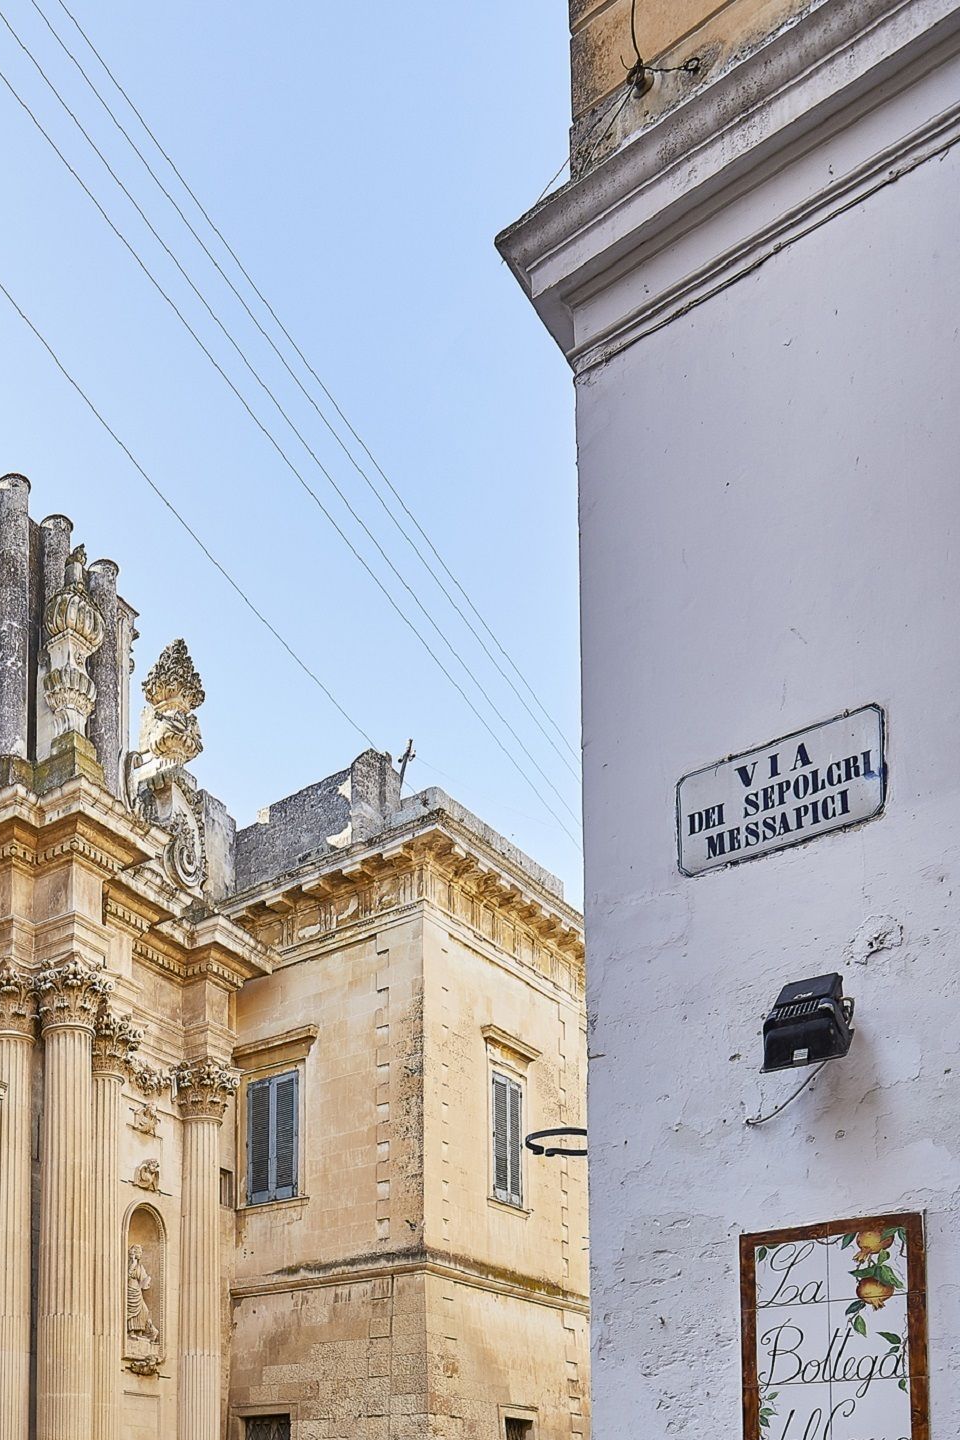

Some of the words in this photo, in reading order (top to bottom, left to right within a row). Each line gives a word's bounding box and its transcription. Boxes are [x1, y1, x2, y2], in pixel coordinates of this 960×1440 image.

[687, 802, 725, 837] DEI
[742, 749, 873, 819] SEPOLCRI
[734, 742, 813, 788] VIA
[705, 788, 851, 860] MESSAPICI
[756, 1242, 828, 1309] La
[757, 1317, 909, 1399] Bottega
